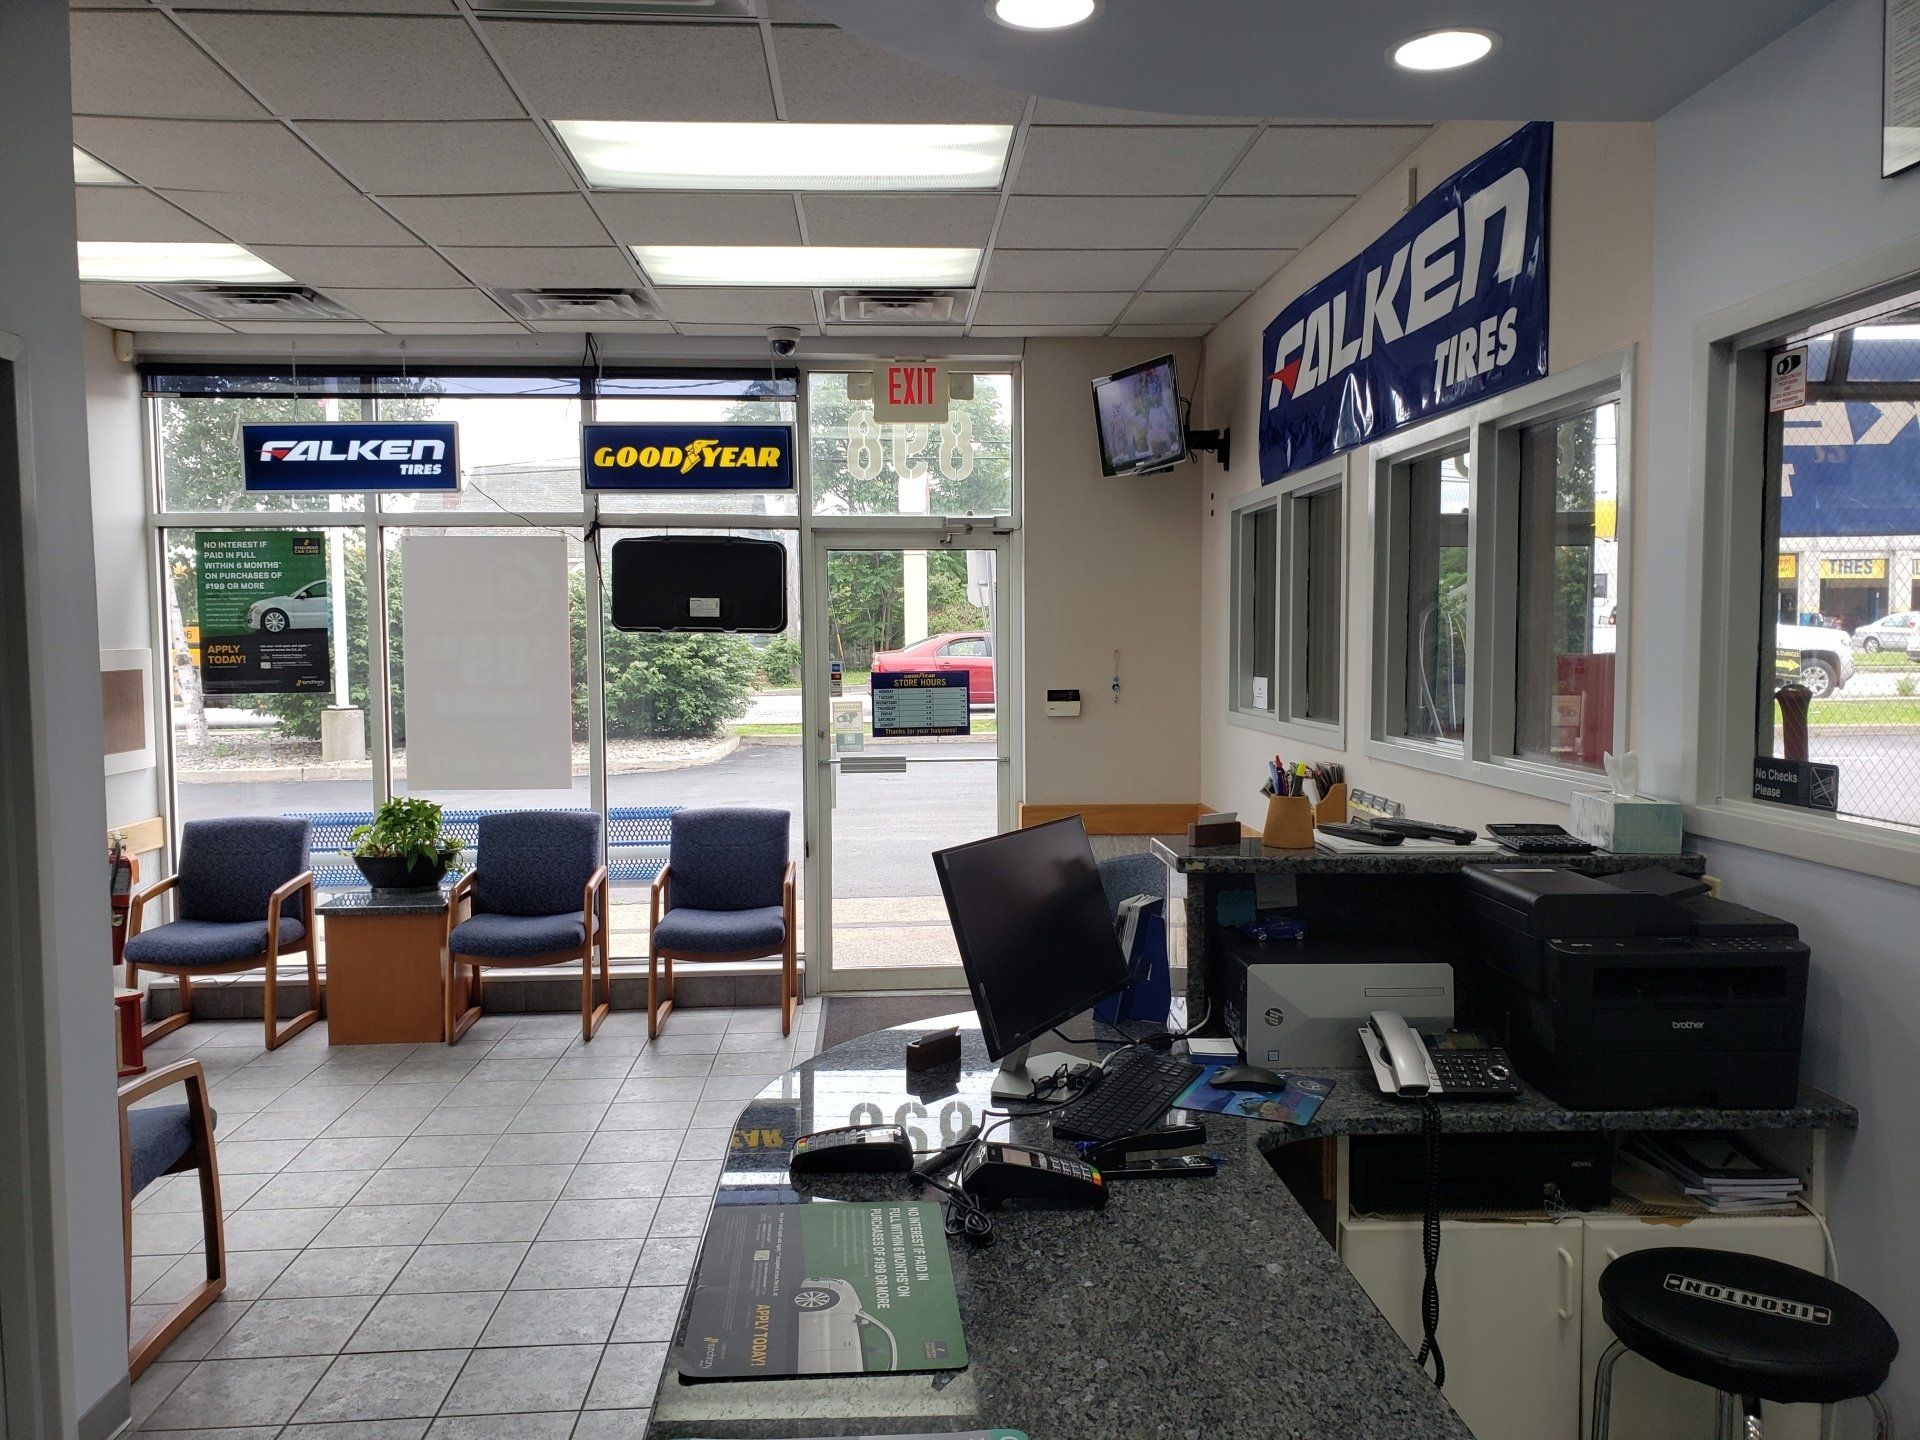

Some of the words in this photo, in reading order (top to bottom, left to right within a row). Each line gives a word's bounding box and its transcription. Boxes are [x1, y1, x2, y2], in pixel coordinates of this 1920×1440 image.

[1268, 167, 1530, 411] FALKEN
[1434, 306, 1519, 396] TIRES
[888, 367, 937, 405] EXIT
[259, 439, 446, 462] FALKEN
[400, 463, 442, 475] TIRES
[203, 541, 217, 549] NO
[218, 541, 258, 549] INTEREST
[259, 540, 268, 548] IF
[203, 551, 224, 559] PAID
[225, 551, 235, 559] IN
[236, 551, 256, 559] FULL
[204, 562, 235, 570] WITHIN
[1829, 559, 1873, 575] TIRES
[204, 572, 218, 580] ON
[219, 571, 270, 580] PURCHASES
[271, 571, 283, 579] OF
[205, 582, 225, 590] $199
[226, 582, 239, 590] OR
[240, 582, 265, 590] MORE
[208, 645, 241, 654] APPLY
[208, 655, 247, 664] TODAY!
[893, 678, 918, 687] STORE
[920, 678, 947, 686] HOURS
[1755, 767, 1767, 780] No
[1768, 768, 1798, 783] Checks
[1754, 783, 1781, 798] Please
[1672, 1020, 1705, 1029] brother
[888, 1207, 902, 1224] FULL
[907, 1207, 919, 1217] NO
[870, 1207, 886, 1246] PURCHASES
[908, 1217, 925, 1247] INTEREST
[890, 1223, 904, 1247] WITHIN
[872, 1246, 887, 1256] OF
[913, 1247, 926, 1255] IF
[873, 1256, 888, 1274] $199
[914, 1255, 928, 1272] PAID
[875, 1275, 889, 1286] OR
[917, 1273, 930, 1281] IN
[876, 1286, 891, 1309] MORE
[897, 1286, 911, 1297] ON
[1683, 1279, 1812, 1319] IRONTON
[754, 1303, 771, 1331] APPLY
[751, 1332, 769, 1367] TODAY!
